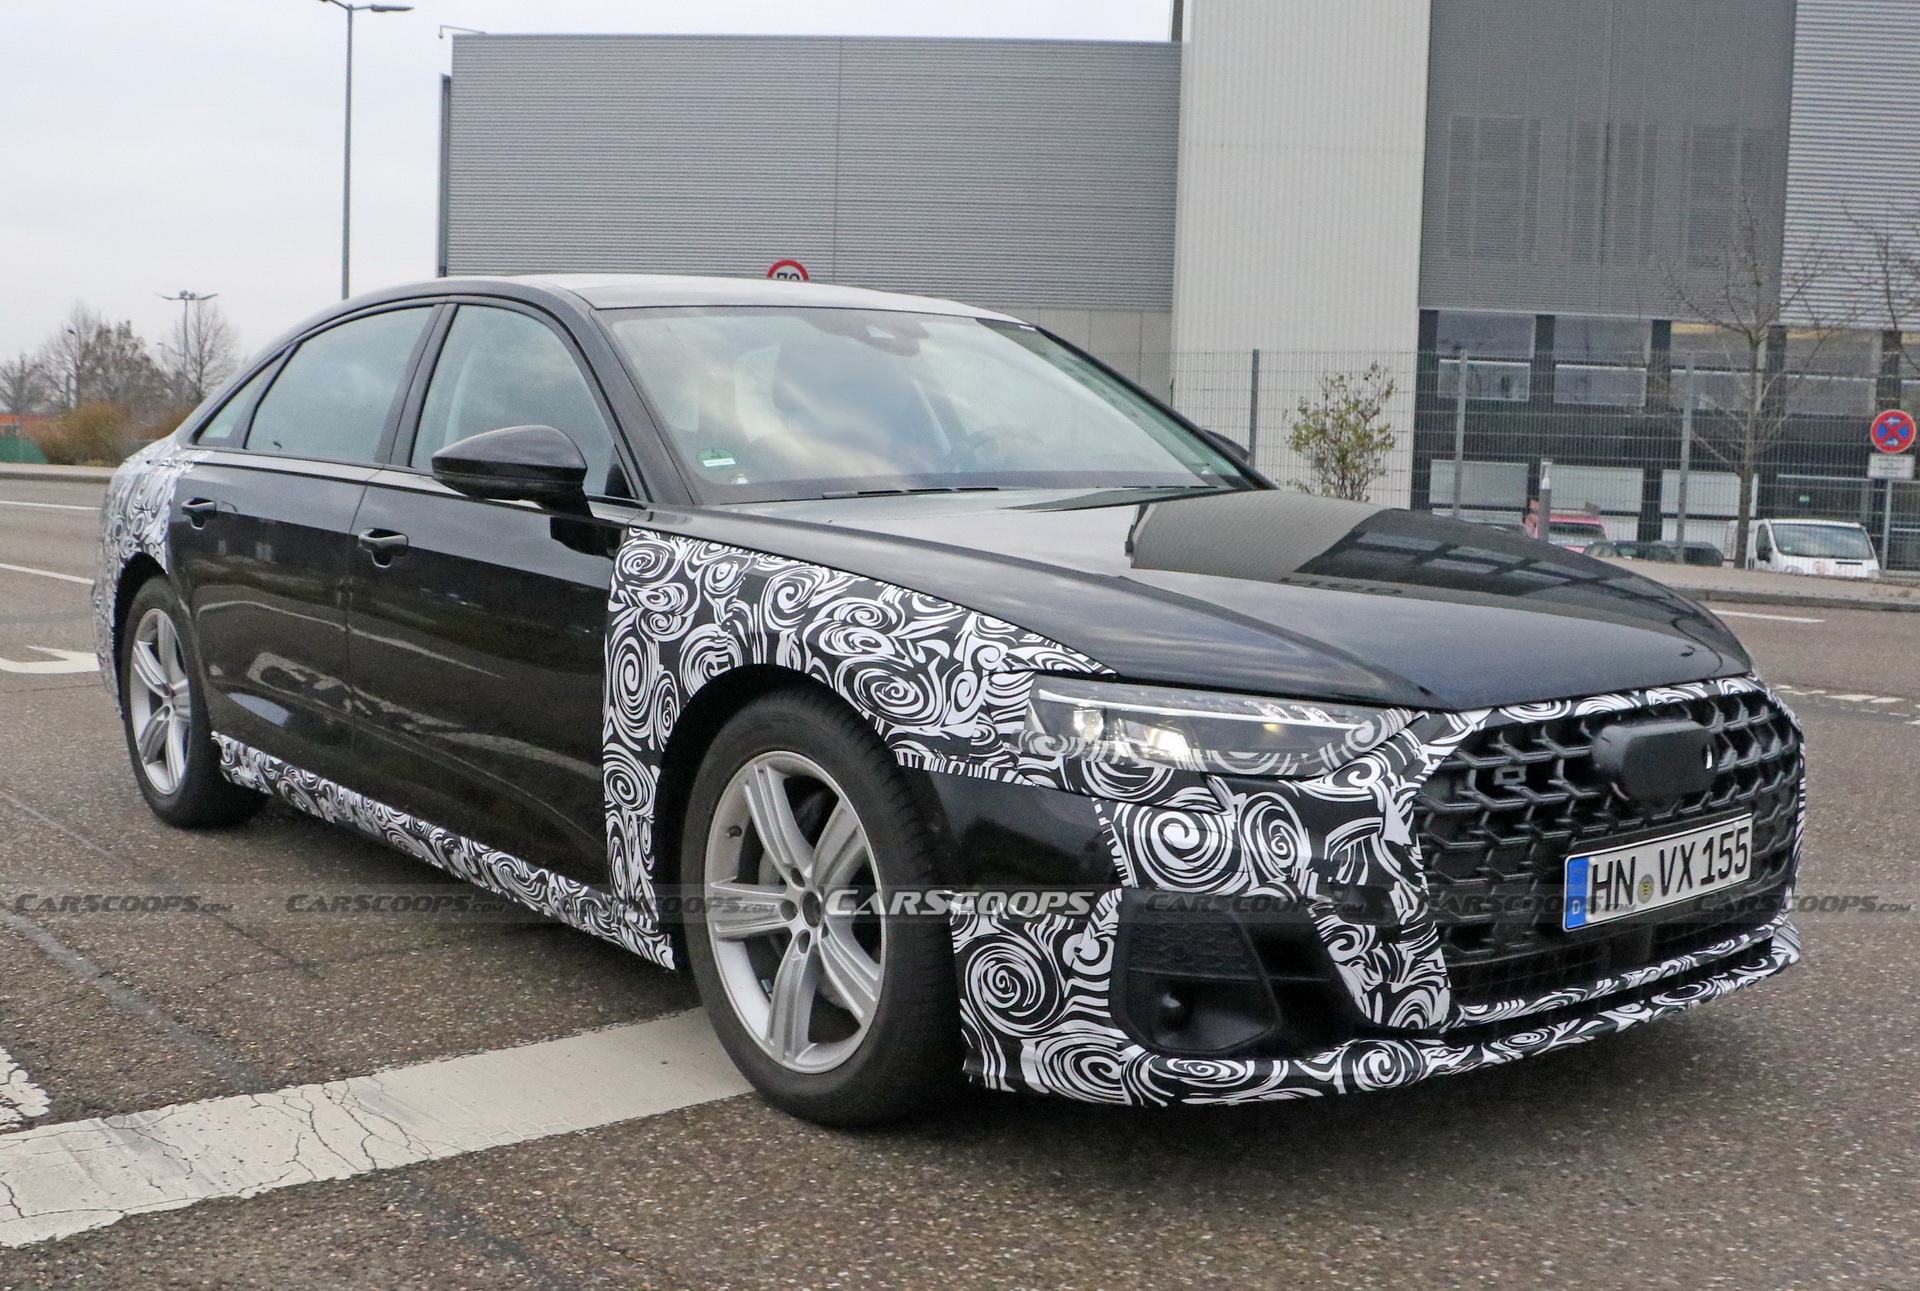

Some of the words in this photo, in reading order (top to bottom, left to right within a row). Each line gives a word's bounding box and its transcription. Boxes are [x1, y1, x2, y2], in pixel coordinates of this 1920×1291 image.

[1590, 856, 1636, 914] HN
[1659, 841, 1697, 897] VX
[1700, 826, 1750, 886] 155
[1572, 900, 1581, 915] D
